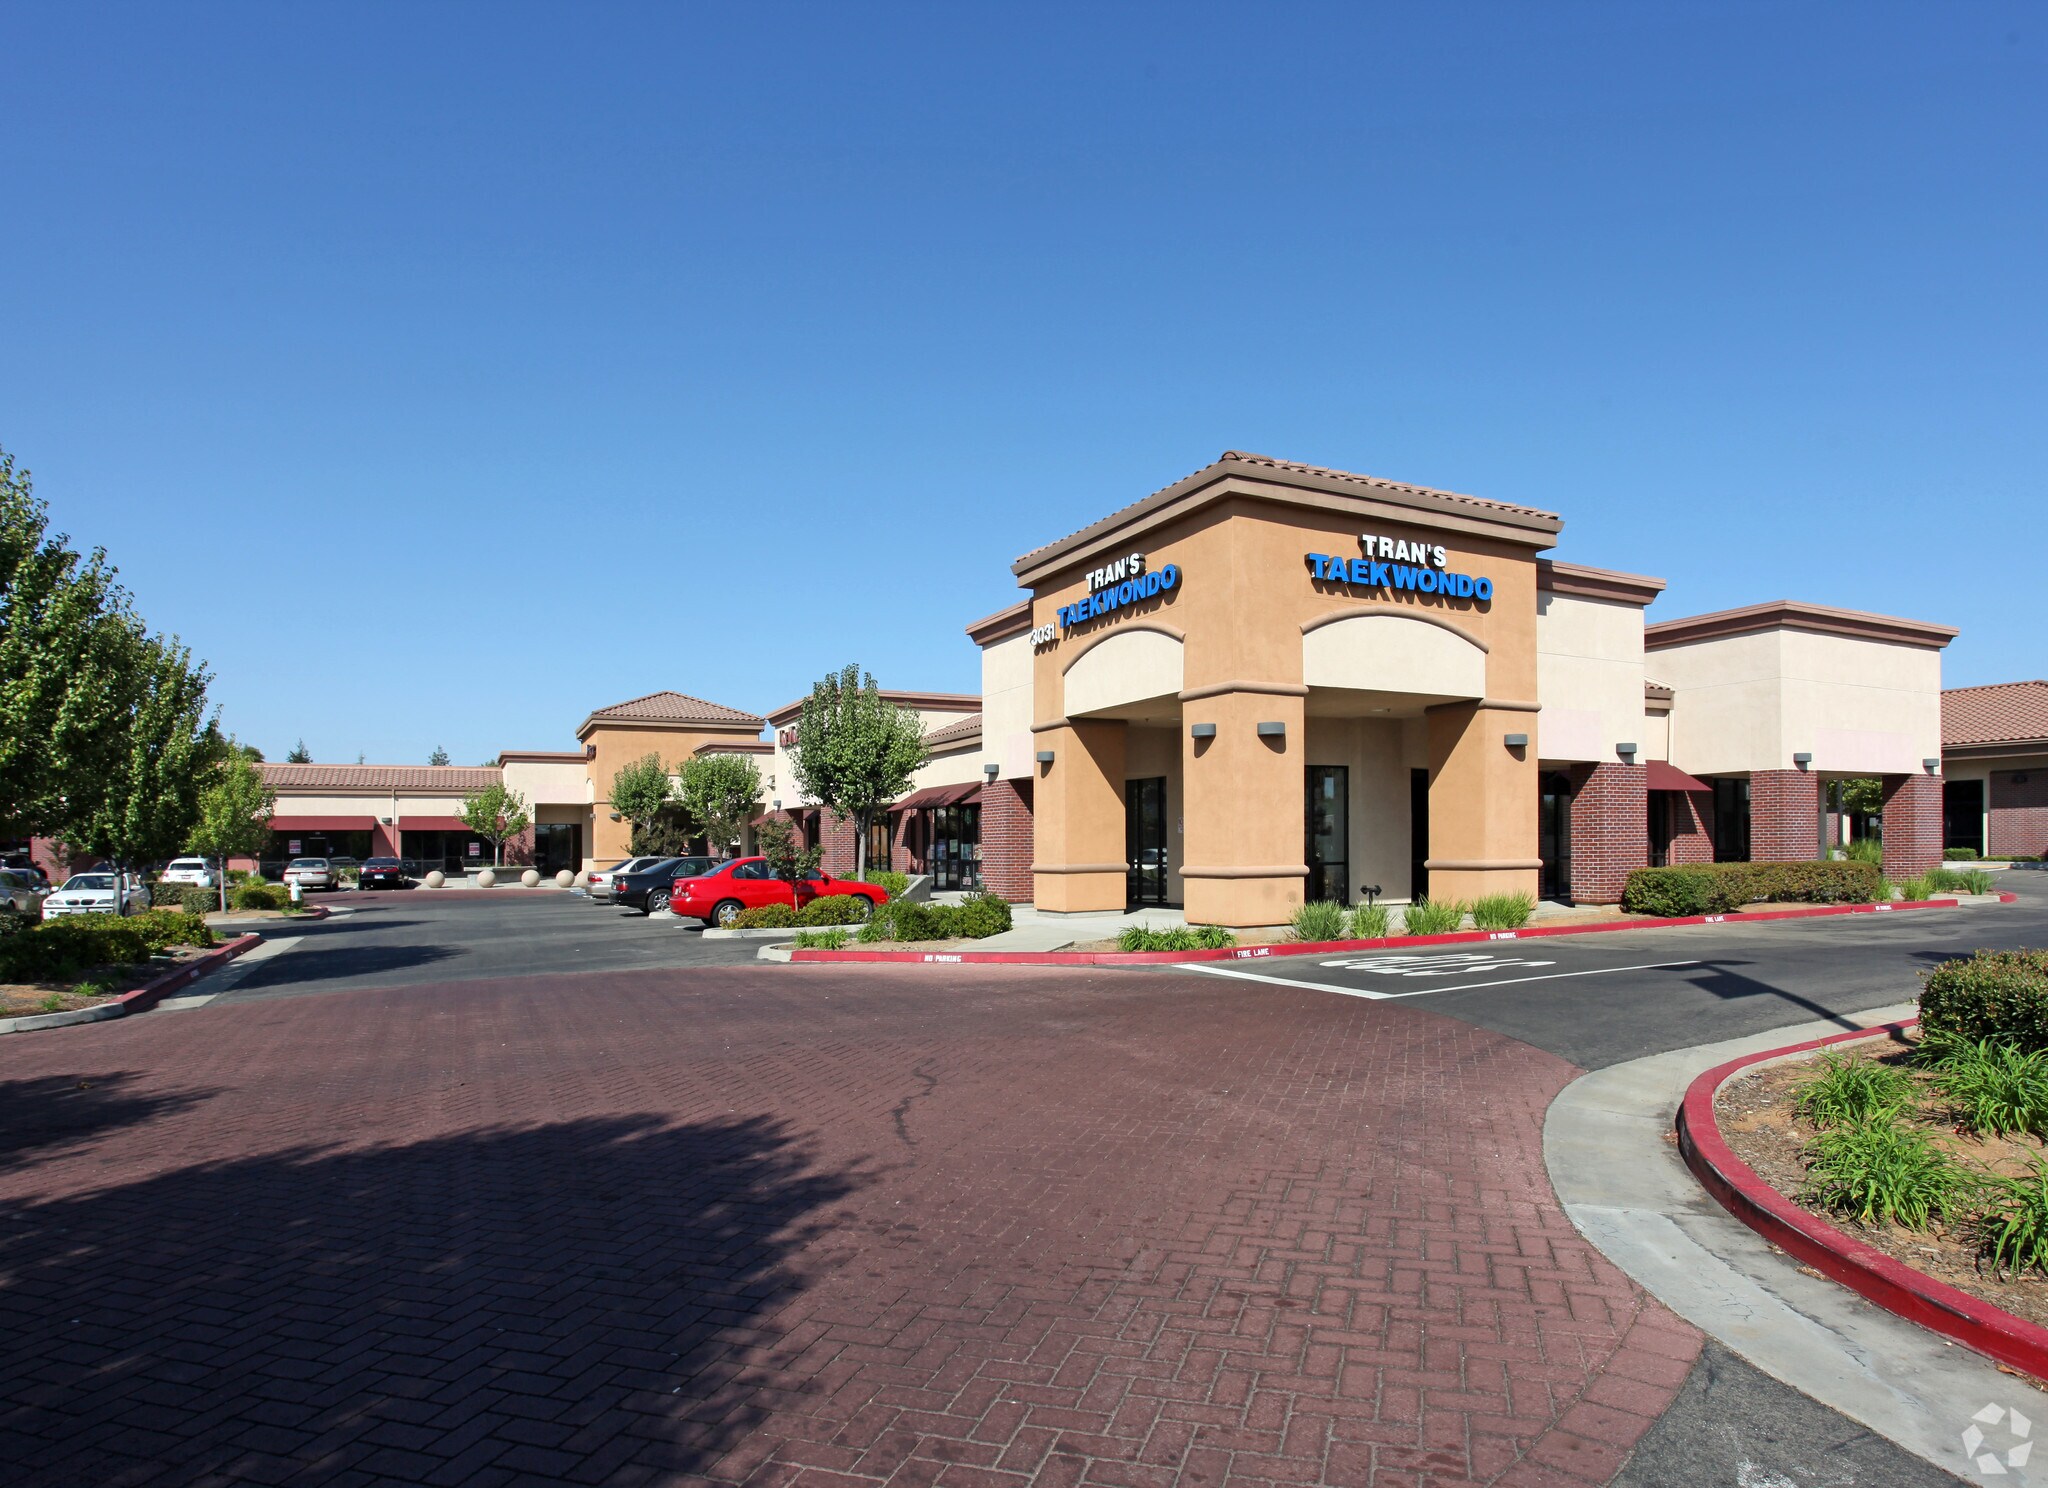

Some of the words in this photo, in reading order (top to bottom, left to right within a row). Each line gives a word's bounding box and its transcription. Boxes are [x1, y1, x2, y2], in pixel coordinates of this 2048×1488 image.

[1361, 534, 1447, 567] TRAN'S
[1085, 552, 1140, 592] TRAN'S
[1307, 552, 1494, 600] TAEKWONDO
[1056, 563, 1177, 629] TAEKWONDO
[1031, 622, 1055, 646] 3031
[1237, 950, 1251, 958] FIRE
[1253, 948, 1269, 956] LANE
